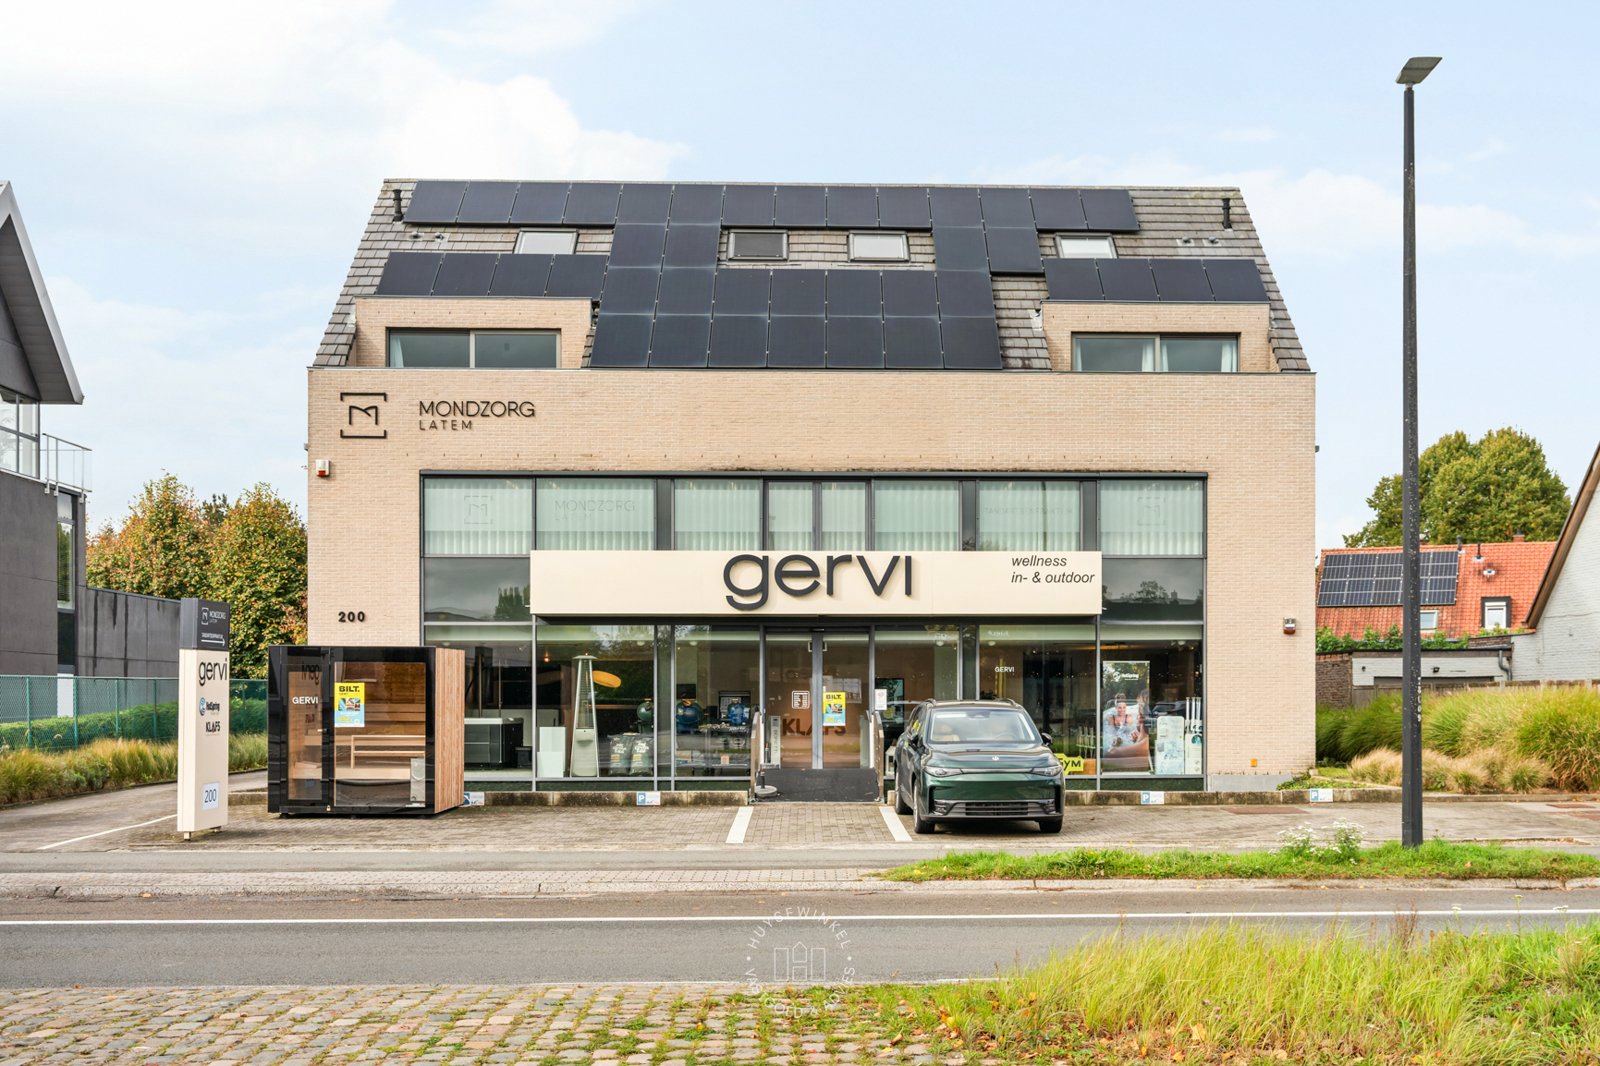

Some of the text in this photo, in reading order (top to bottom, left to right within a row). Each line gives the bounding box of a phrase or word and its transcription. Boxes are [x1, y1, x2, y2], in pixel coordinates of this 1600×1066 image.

[419, 400, 536, 418] MONDZORG
[419, 420, 473, 431] LATEM
[1011, 555, 1068, 567] wellness
[723, 553, 913, 612] gervi
[1011, 571, 1096, 584] in- & outdoor
[337, 610, 367, 623] 200
[198, 658, 228, 687] gervi
[338, 685, 360, 693] BILT.
[292, 696, 319, 705] GERVI
[204, 788, 217, 804] 200
